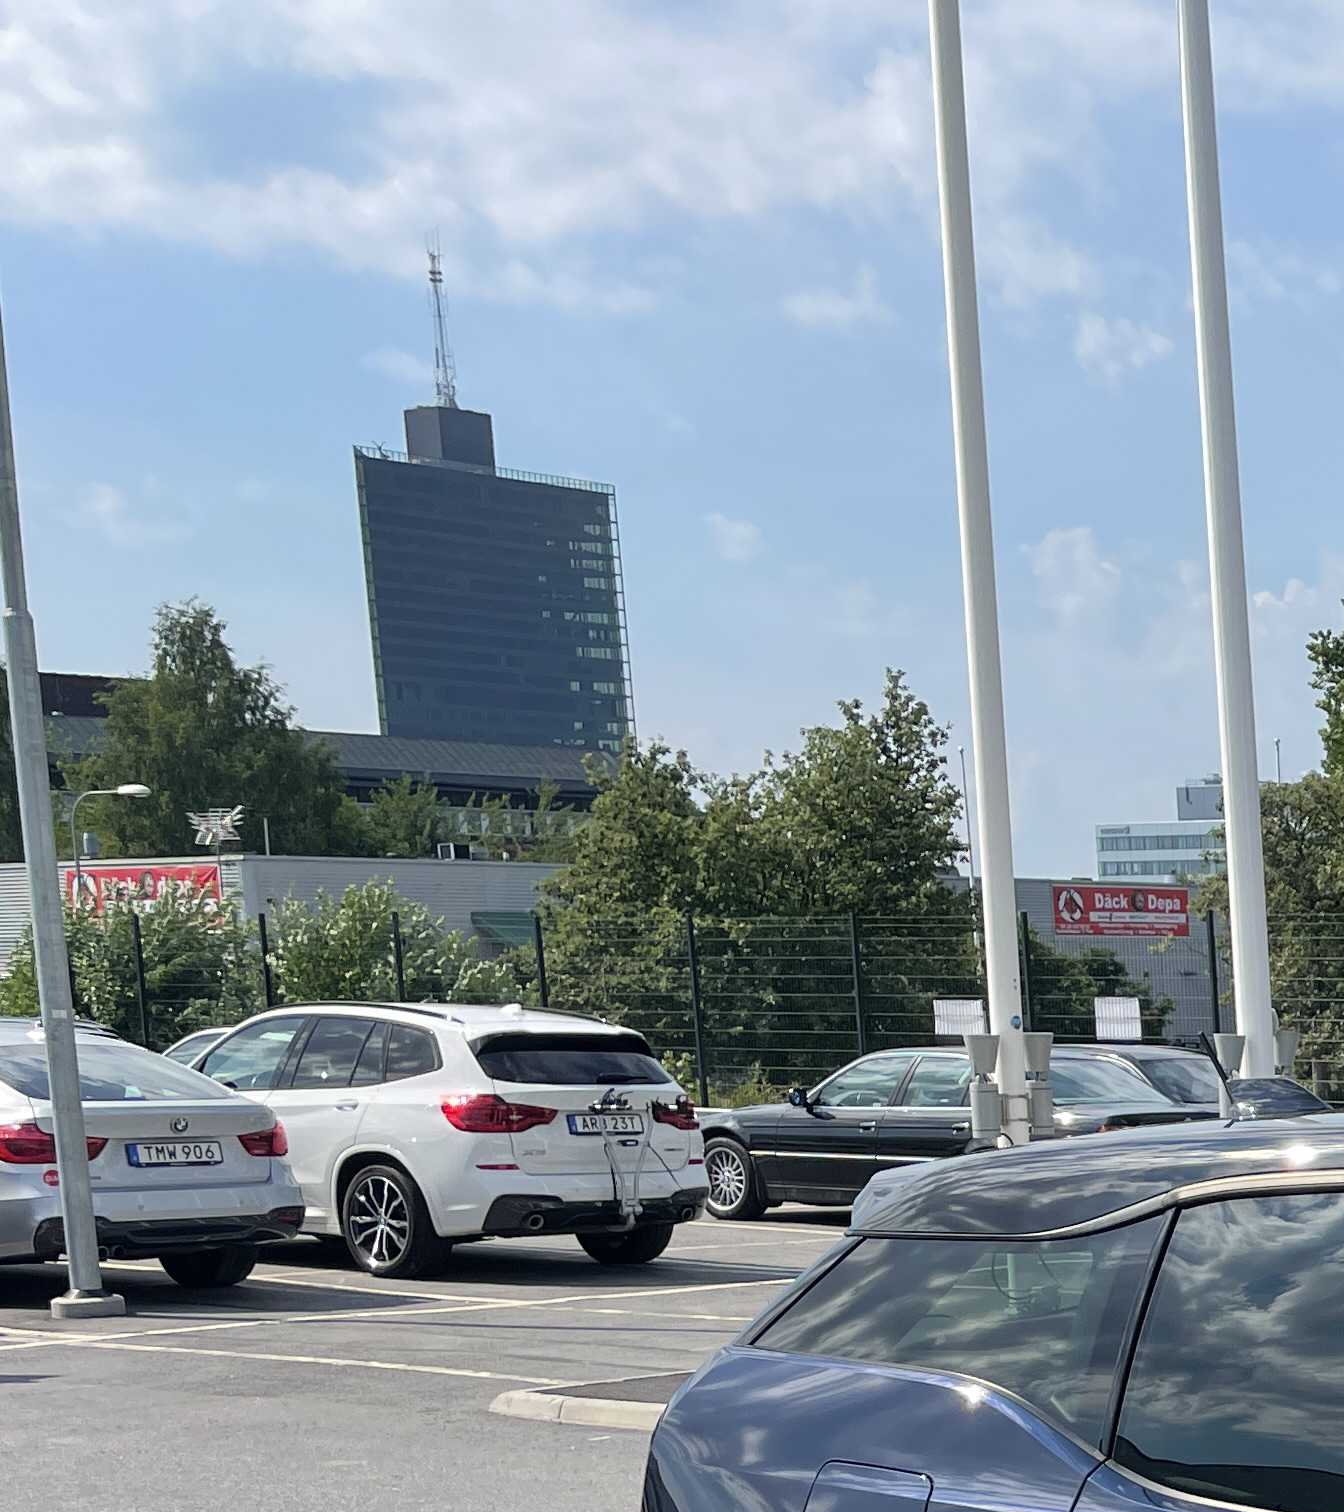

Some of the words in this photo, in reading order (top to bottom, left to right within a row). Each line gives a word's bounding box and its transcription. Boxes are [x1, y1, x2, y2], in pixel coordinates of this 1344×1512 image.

[1094, 892, 1129, 909] Däck
[611, 1116, 636, 1130] 23T
[143, 1144, 178, 1161] TMW
[182, 1144, 216, 1160] 906
